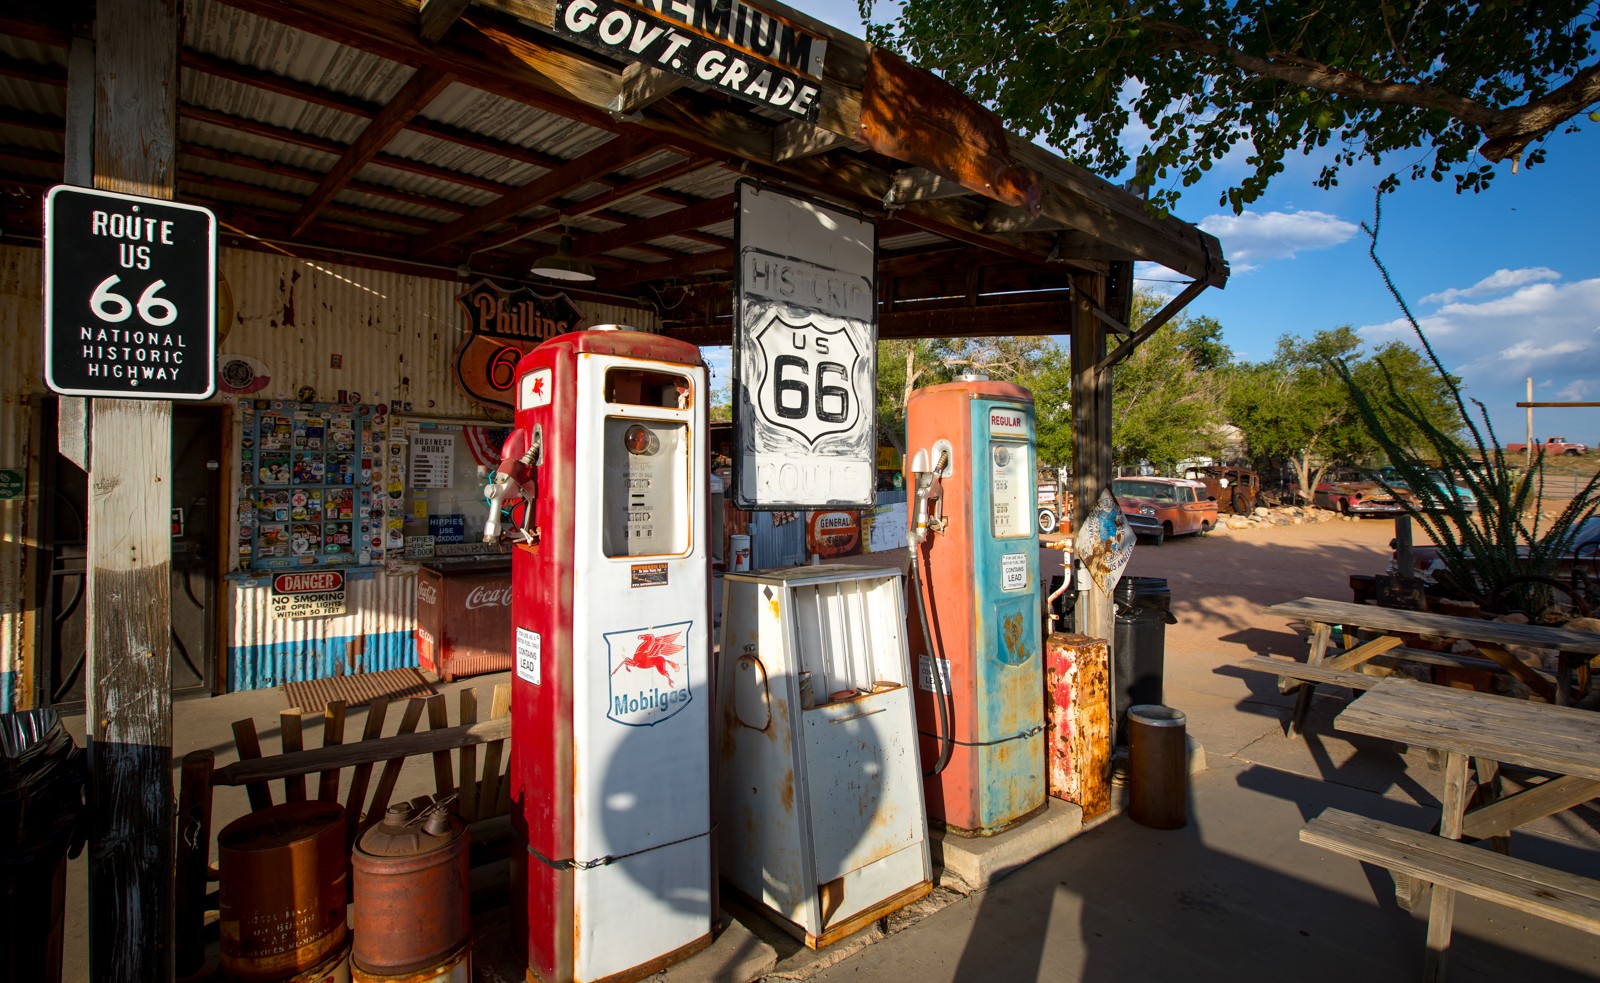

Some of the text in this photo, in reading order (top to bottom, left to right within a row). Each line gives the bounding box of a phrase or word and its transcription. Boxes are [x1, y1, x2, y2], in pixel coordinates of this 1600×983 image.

[564, 0, 819, 115] GOV'T. GRADE
[92, 210, 174, 245] ROUTE
[120, 243, 151, 270] US
[89, 274, 178, 326] 66
[474, 292, 568, 340] Phillips
[81, 327, 186, 348] NATIONAL
[792, 332, 830, 355] US
[83, 345, 183, 364] HISTORIC
[88, 363, 179, 381] HIGHWAY
[774, 354, 848, 423] 66
[991, 415, 1021, 428] REGULAR
[415, 438, 452, 446] BUSINESS
[820, 517, 851, 528] GENERAL
[417, 548, 434, 557] DOOR
[439, 542, 495, 555] GENERAL
[284, 574, 334, 590] DANGER
[1008, 573, 1022, 582] LEAD
[272, 592, 344, 604] NO SMOKING
[465, 585, 513, 610] Coca-C
[424, 630, 434, 644] COLD
[518, 646, 537, 661] CONTAINS
[520, 657, 534, 672] LEAD
[615, 688, 687, 716] Mobilgas
